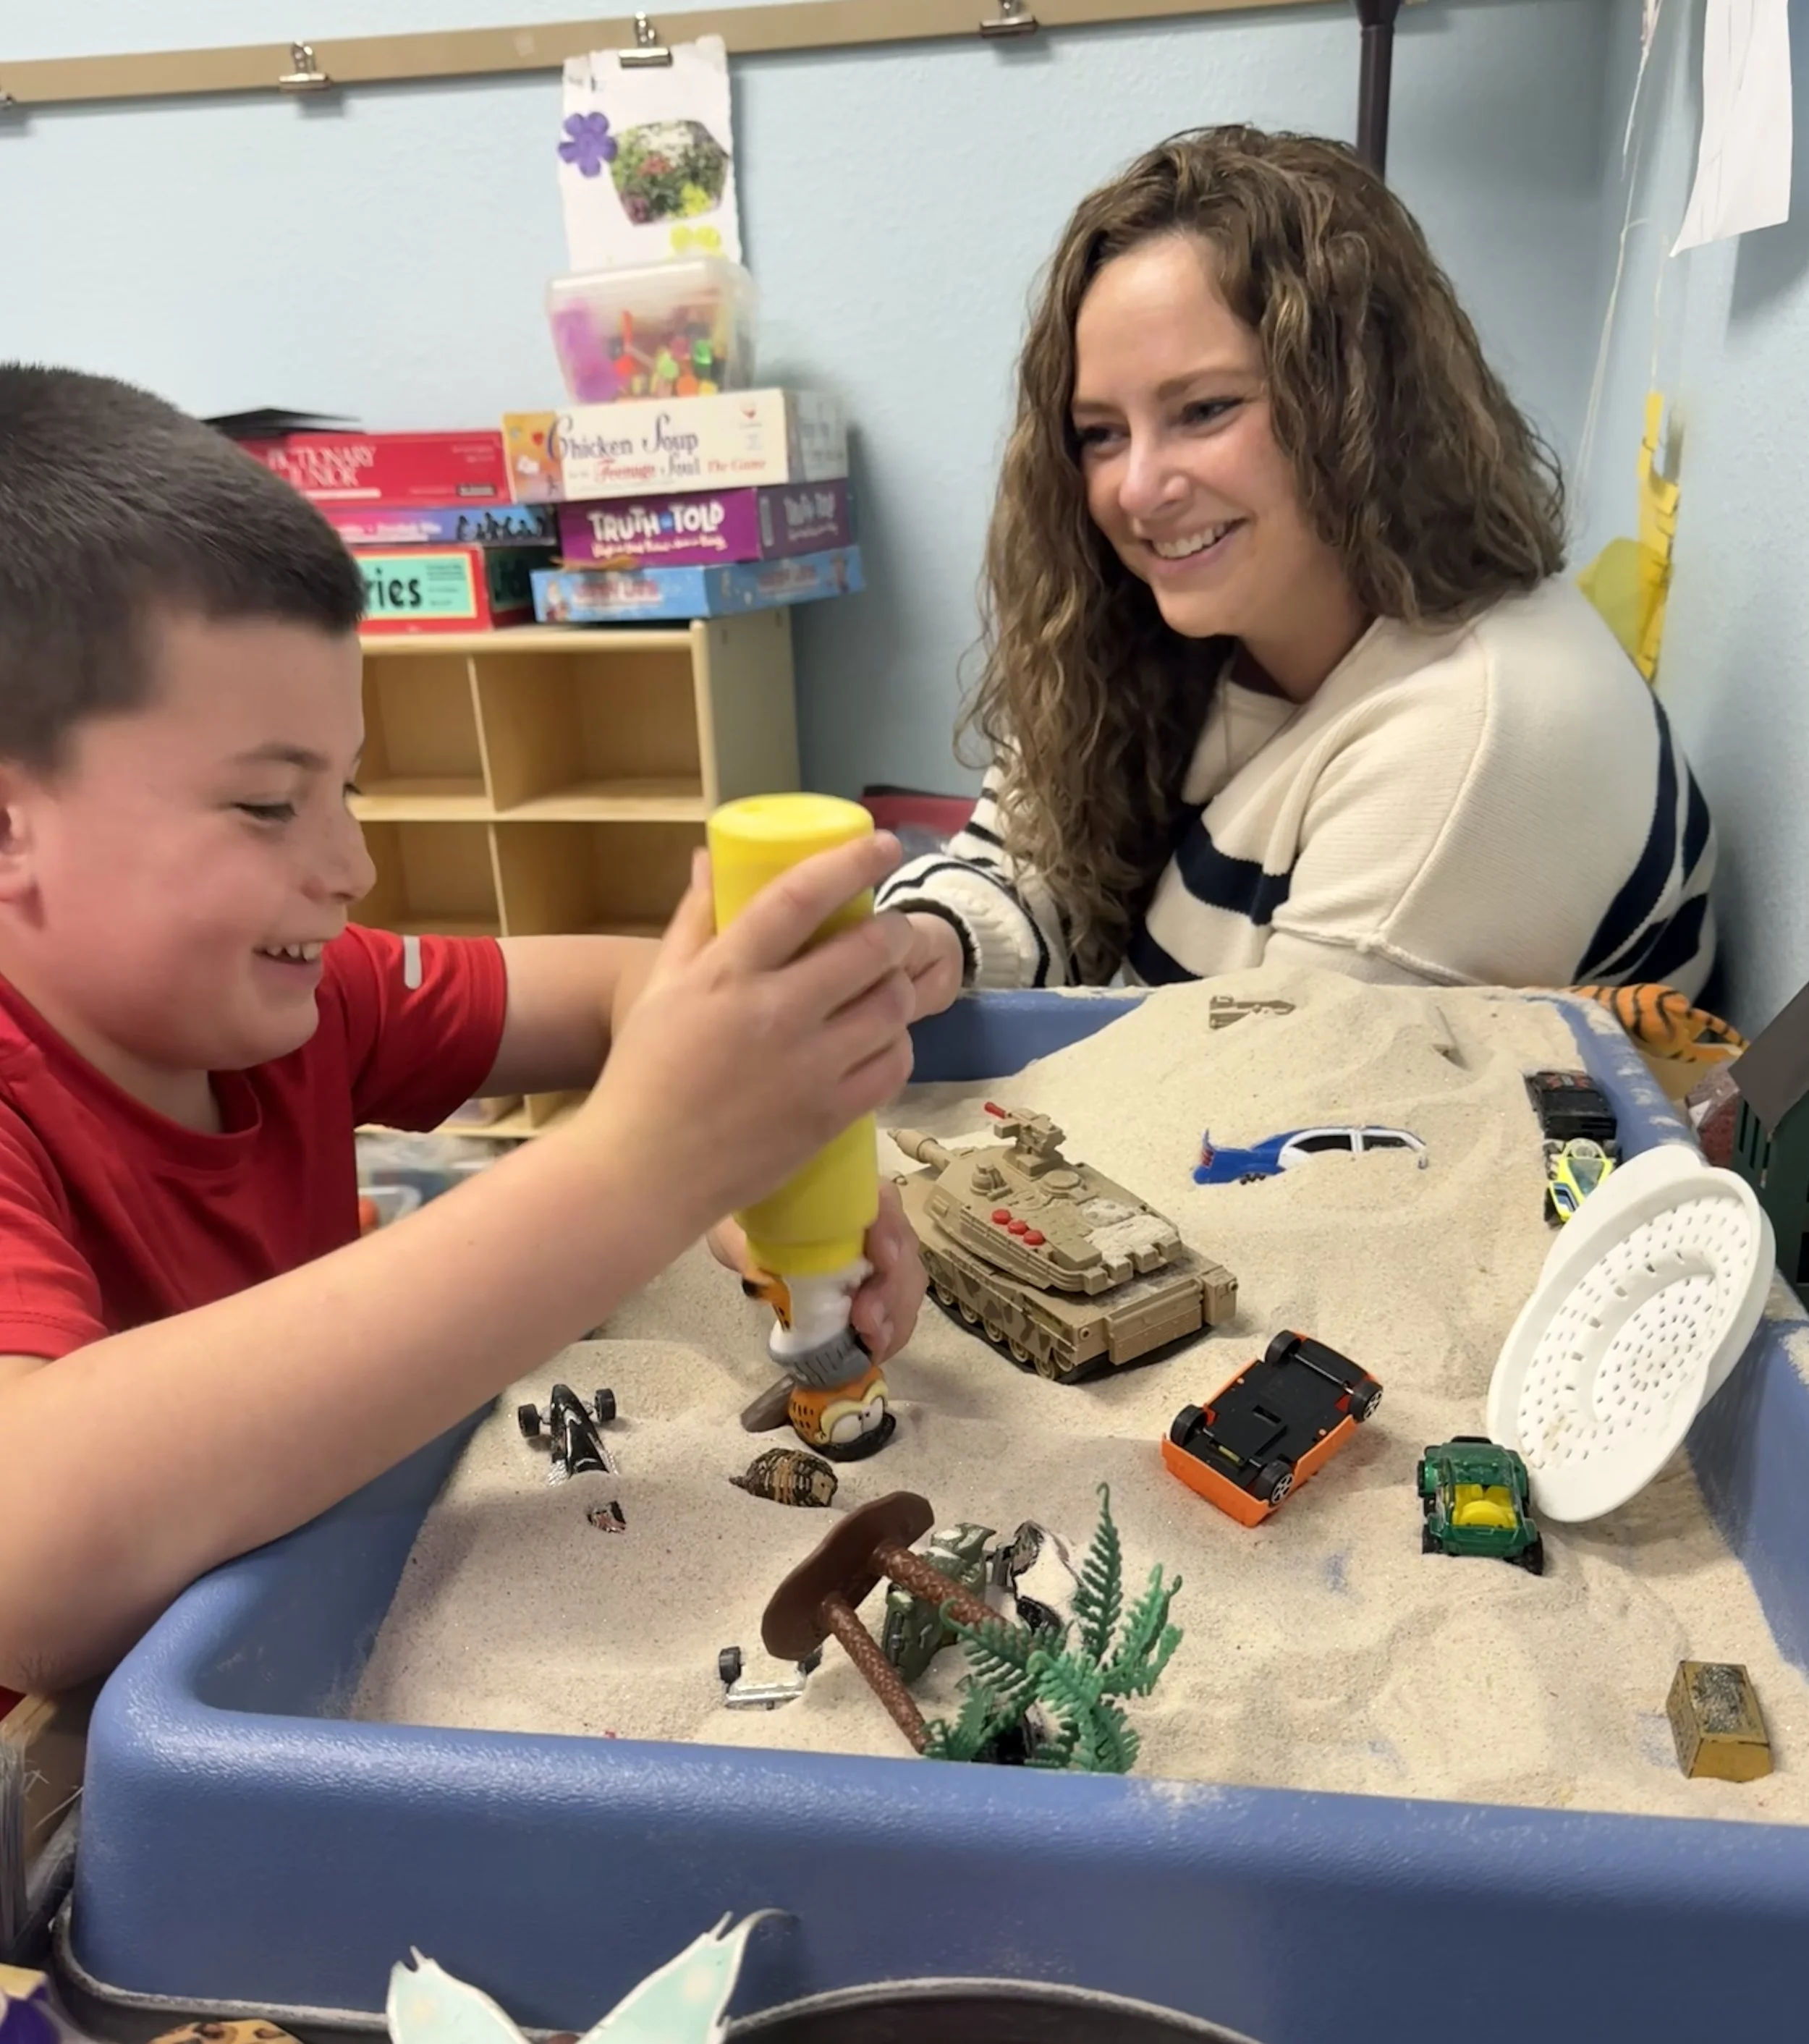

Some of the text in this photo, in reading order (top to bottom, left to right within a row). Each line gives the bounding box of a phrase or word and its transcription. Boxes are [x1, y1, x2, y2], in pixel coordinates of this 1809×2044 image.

[547, 414, 632, 460] Chicken
[642, 412, 699, 454] Soup
[587, 505, 661, 543] TRUTH
[669, 501, 725, 534] TOLD
